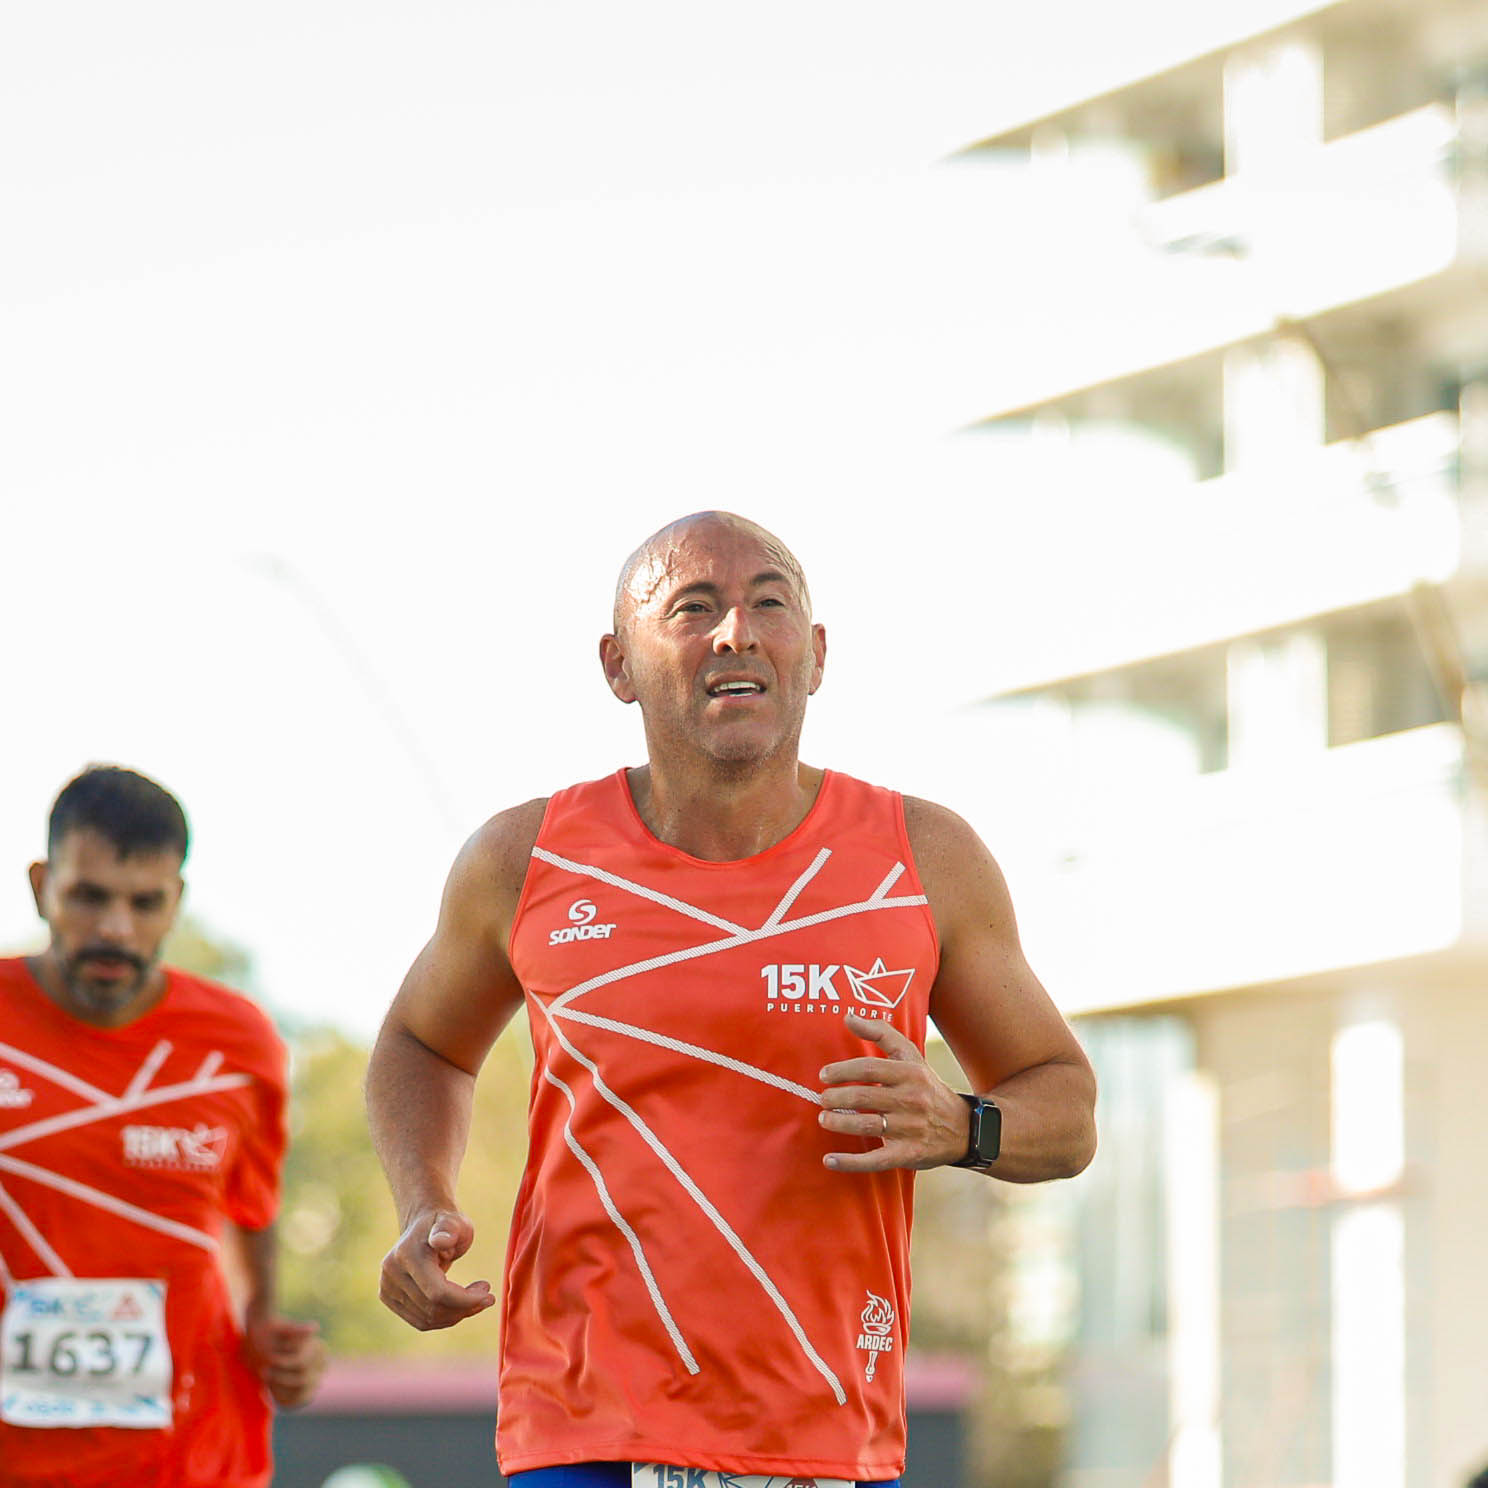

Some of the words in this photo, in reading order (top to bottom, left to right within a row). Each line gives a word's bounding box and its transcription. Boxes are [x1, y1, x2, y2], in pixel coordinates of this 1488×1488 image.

[761, 963, 841, 1001] 15K
[767, 1002, 841, 1015] PUERTO
[847, 1006, 894, 1023] NORTE
[12, 1331, 156, 1378] 1637
[855, 1333, 894, 1352] ARDEC
